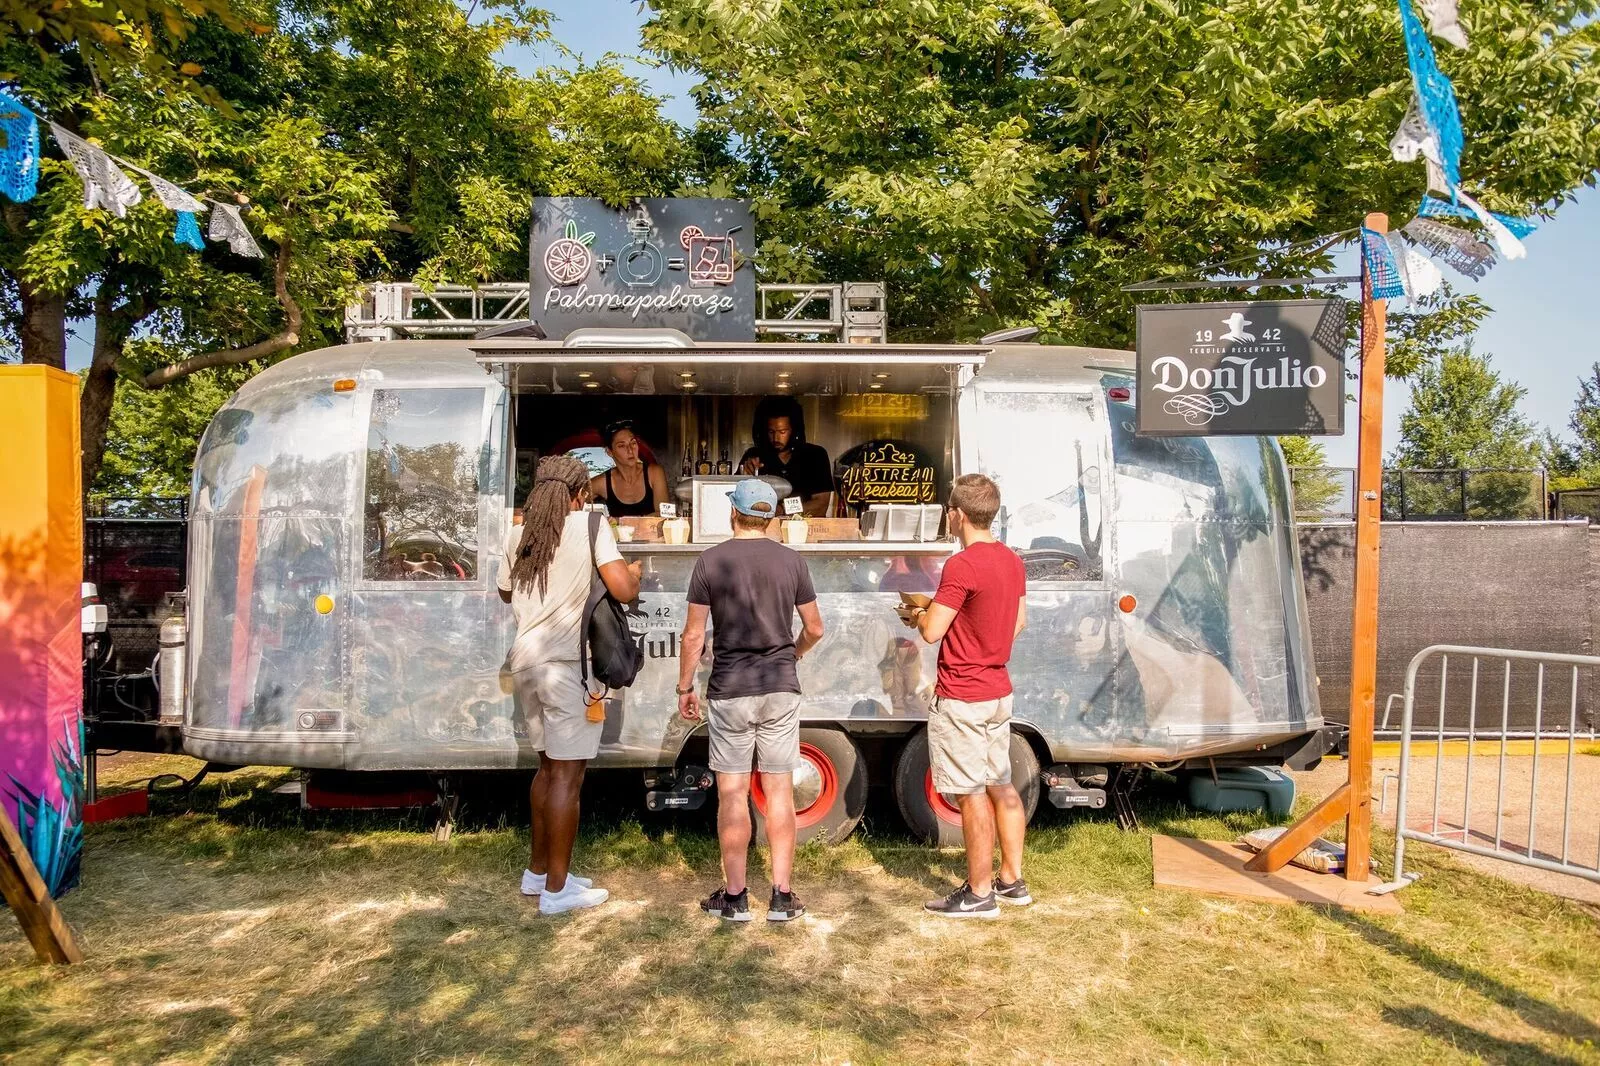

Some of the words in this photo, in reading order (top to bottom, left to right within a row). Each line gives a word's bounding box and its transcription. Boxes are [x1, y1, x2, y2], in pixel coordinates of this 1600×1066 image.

[543, 284, 735, 318] Palomapalooza
[1195, 330, 1213, 342] 19
[1262, 328, 1281, 340] 42
[842, 467, 934, 486] AIRSTREAM
[655, 607, 670, 617] 42
